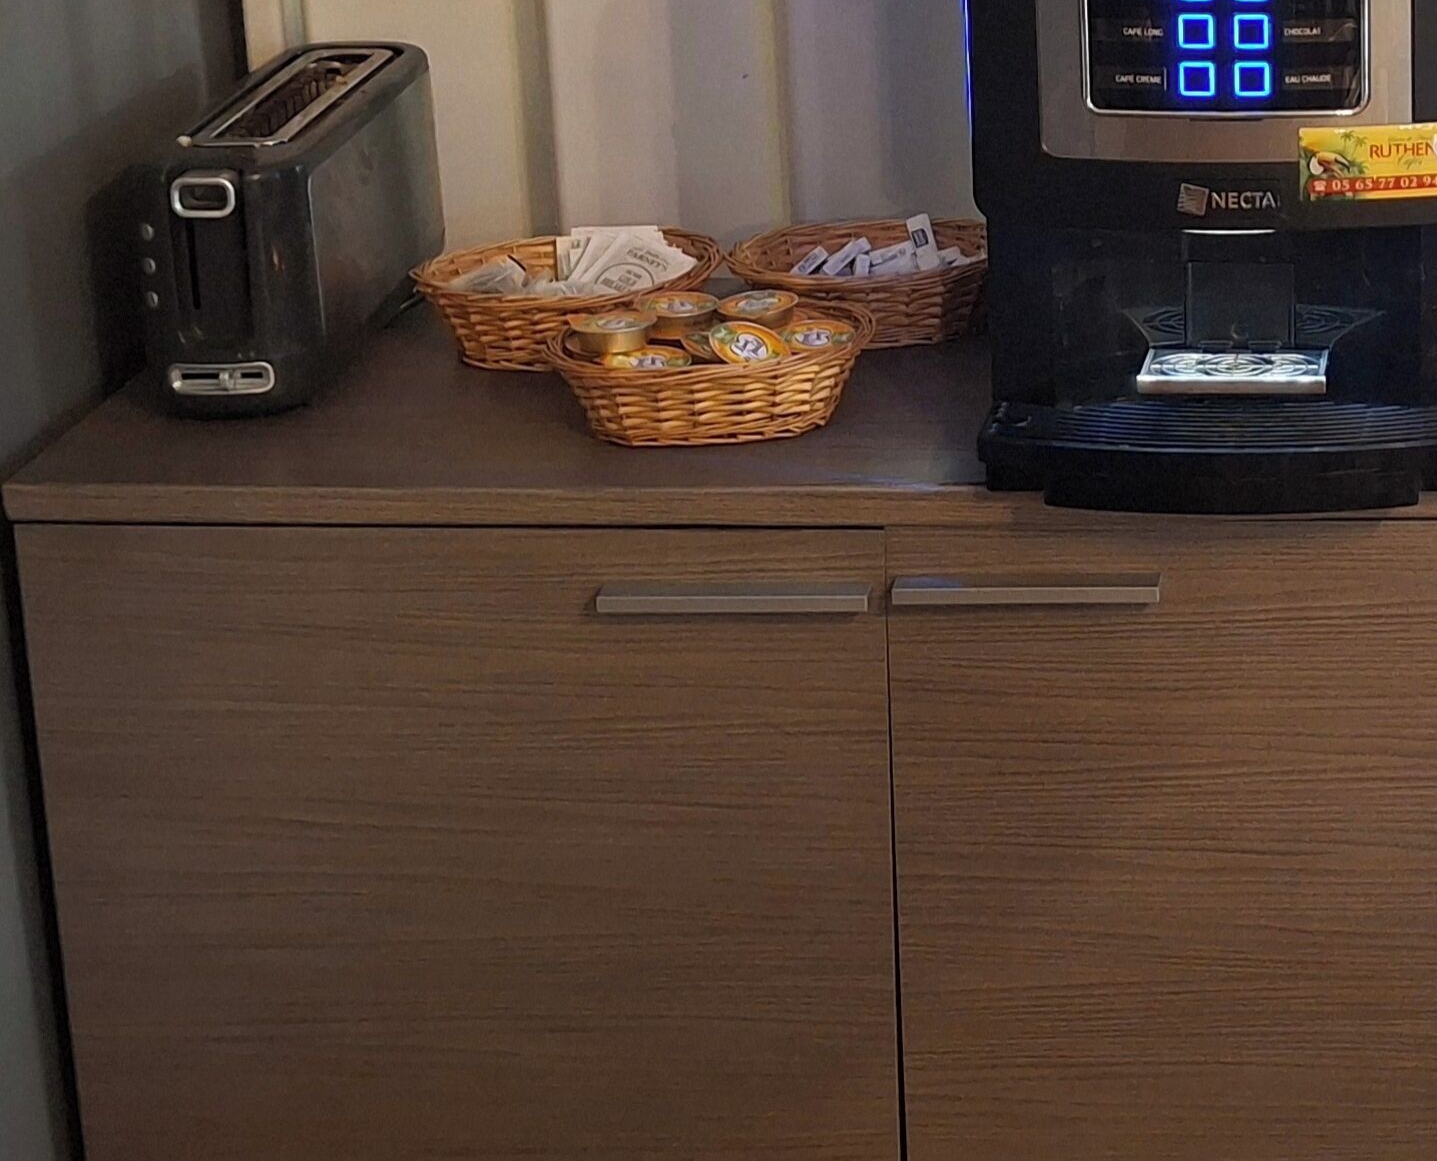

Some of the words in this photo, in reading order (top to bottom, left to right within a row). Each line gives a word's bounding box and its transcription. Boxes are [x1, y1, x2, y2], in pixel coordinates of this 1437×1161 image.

[1284, 75, 1301, 84] EAU
[1331, 179, 1351, 191] 05
[1355, 178, 1373, 191] 65
[1379, 177, 1396, 189] 77
[1400, 176, 1418, 188] 02
[1210, 191, 1277, 209] NECTA
